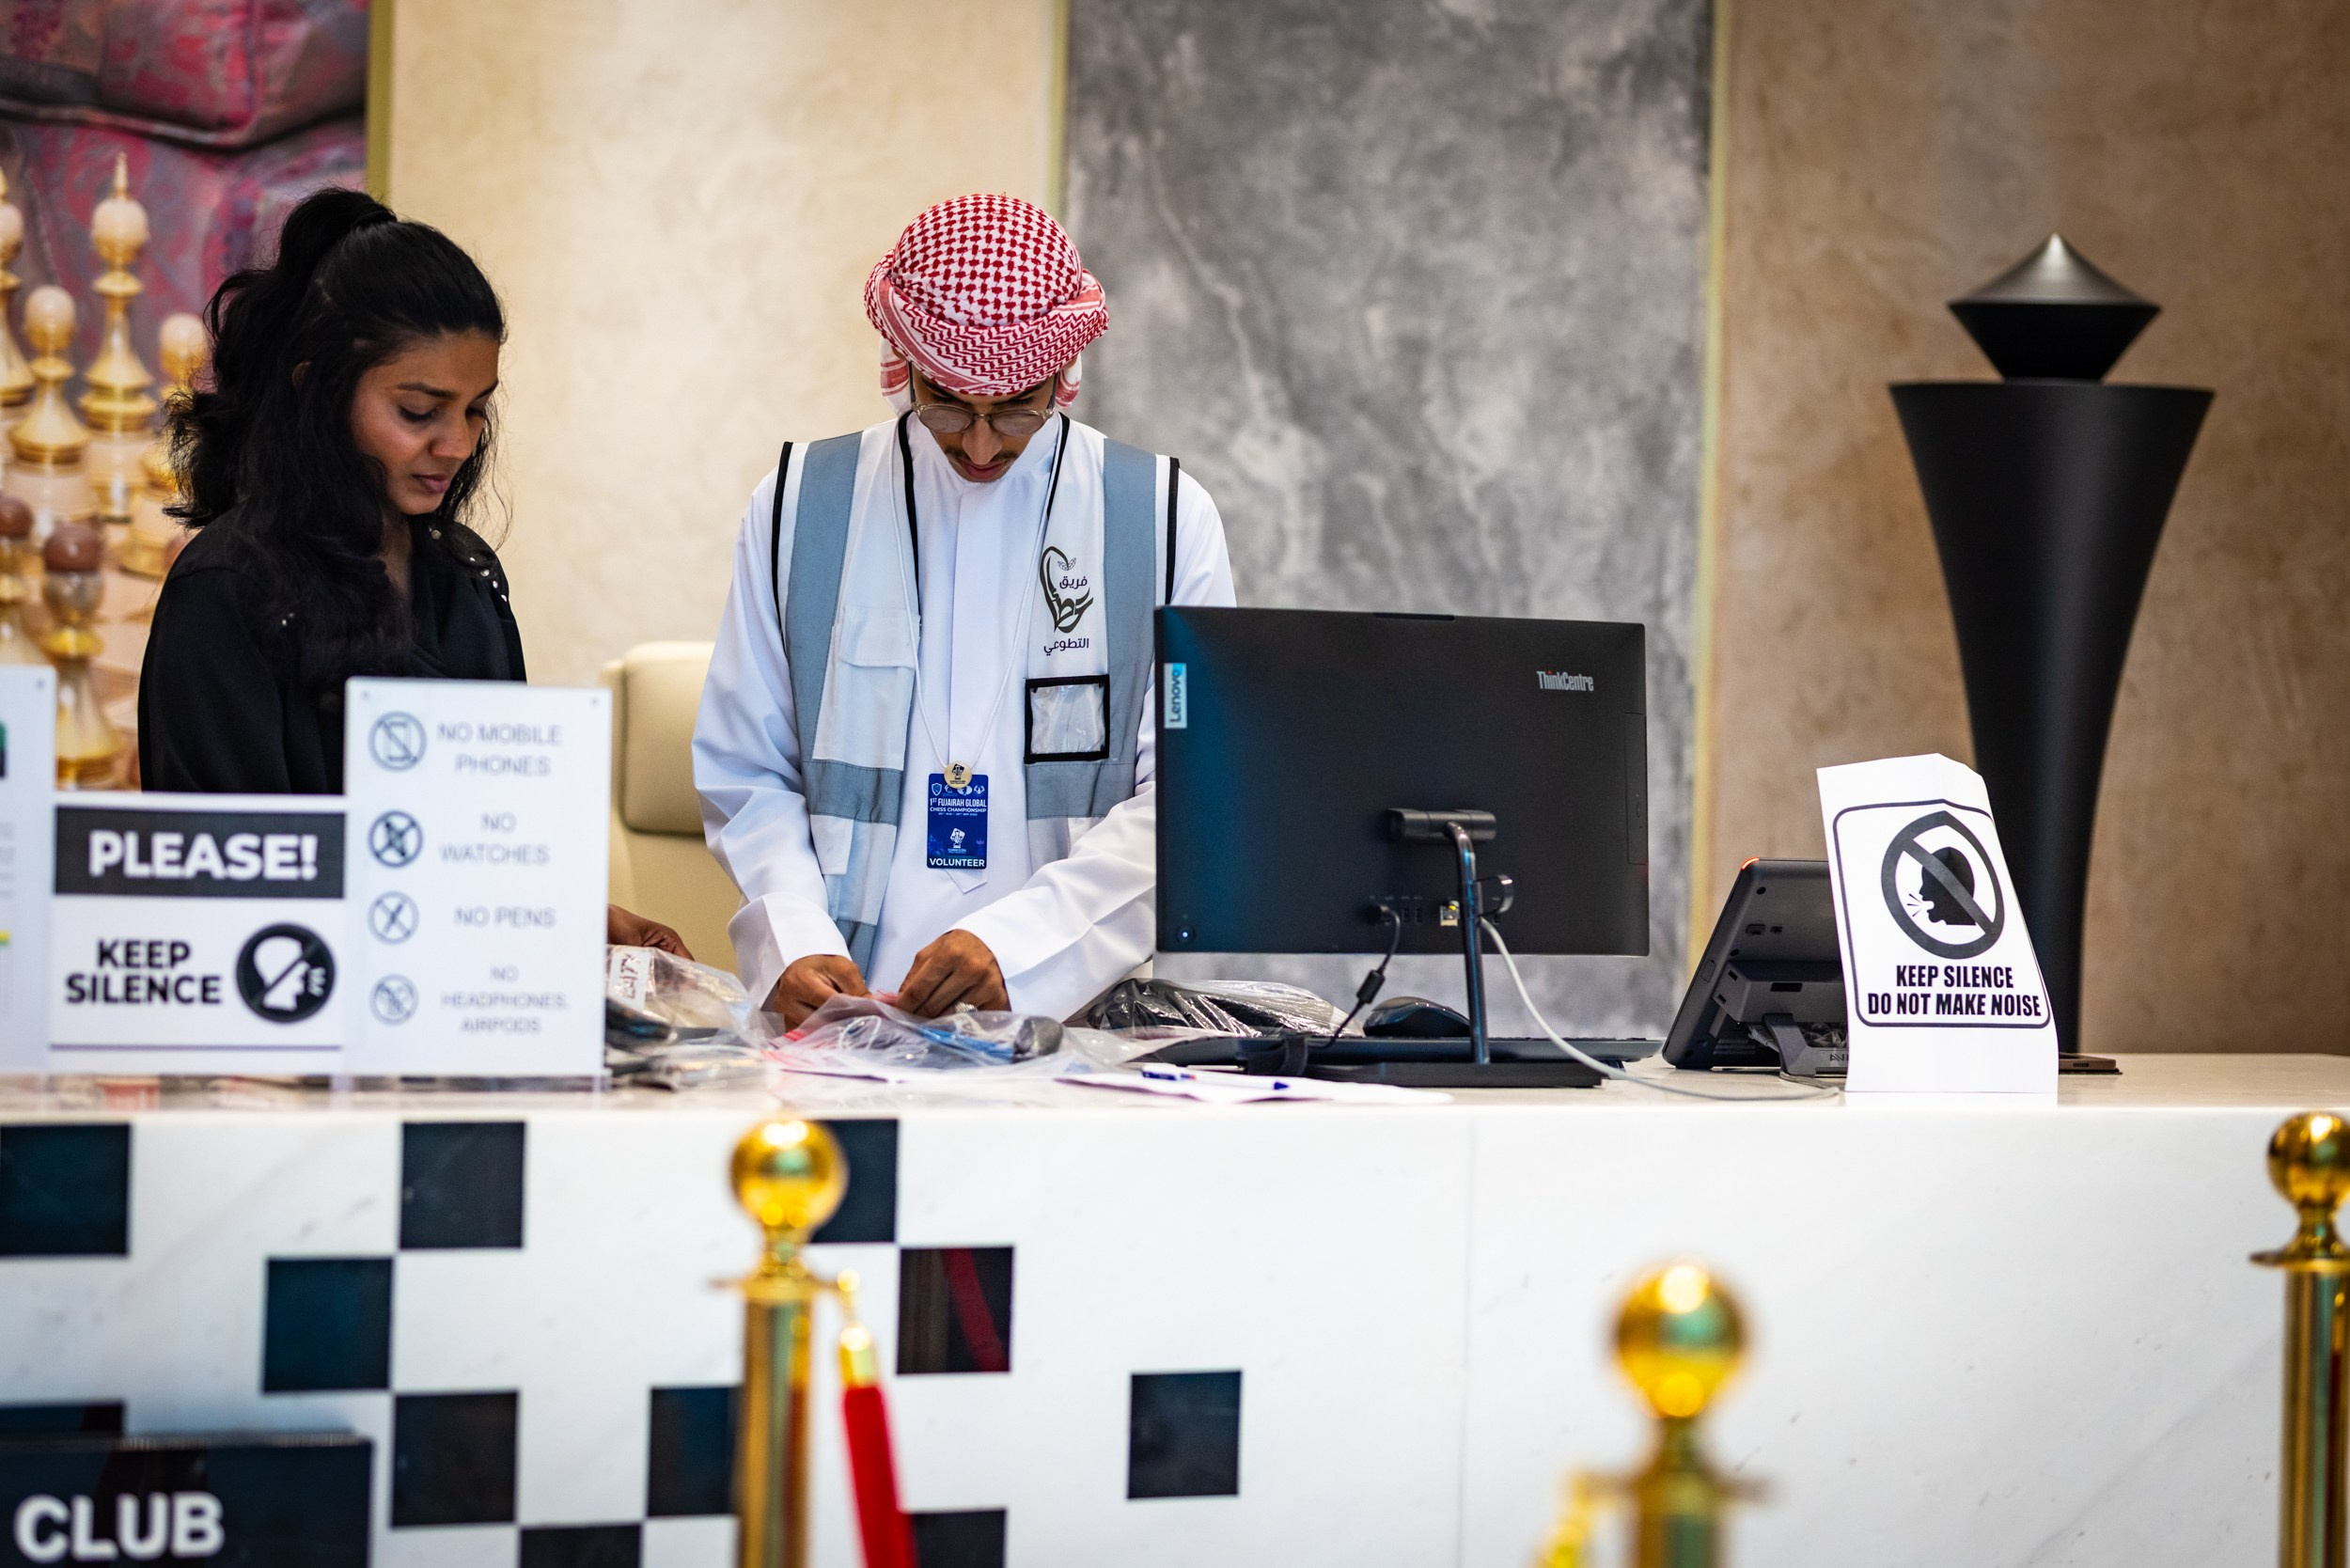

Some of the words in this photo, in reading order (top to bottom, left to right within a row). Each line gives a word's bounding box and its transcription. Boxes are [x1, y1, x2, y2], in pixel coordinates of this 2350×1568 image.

[1059, 576, 1088, 589] فريق
[1043, 638, 1089, 656] التطوعي
[1536, 670, 1594, 692] ThinkCentre
[1169, 668, 1182, 722] Lenovo
[438, 722, 473, 744] NO
[478, 723, 564, 745] MOBILE
[455, 754, 552, 776] PHONES
[938, 798, 964, 807] FUJAIRAH
[965, 799, 987, 808] GLOBAL
[480, 812, 517, 834] NO
[89, 830, 319, 881] PLEASE!
[439, 843, 551, 865] WATCHES
[930, 858, 985, 867] VOLUNTEER
[454, 905, 491, 928] NO
[495, 906, 557, 929] PENS
[98, 940, 191, 969] KEEP
[490, 964, 519, 982] NO
[1896, 965, 1938, 987] KEEP
[1944, 965, 2013, 988] SILENCE
[66, 973, 222, 1004] SILENCE
[1868, 993, 1891, 1015] DO
[1897, 993, 1931, 1015] NOT
[1936, 994, 1986, 1015] MAKE
[1991, 995, 2042, 1016] NOISE
[460, 1016, 542, 1034] AIRPODS
[14, 1492, 226, 1563] CLUB
